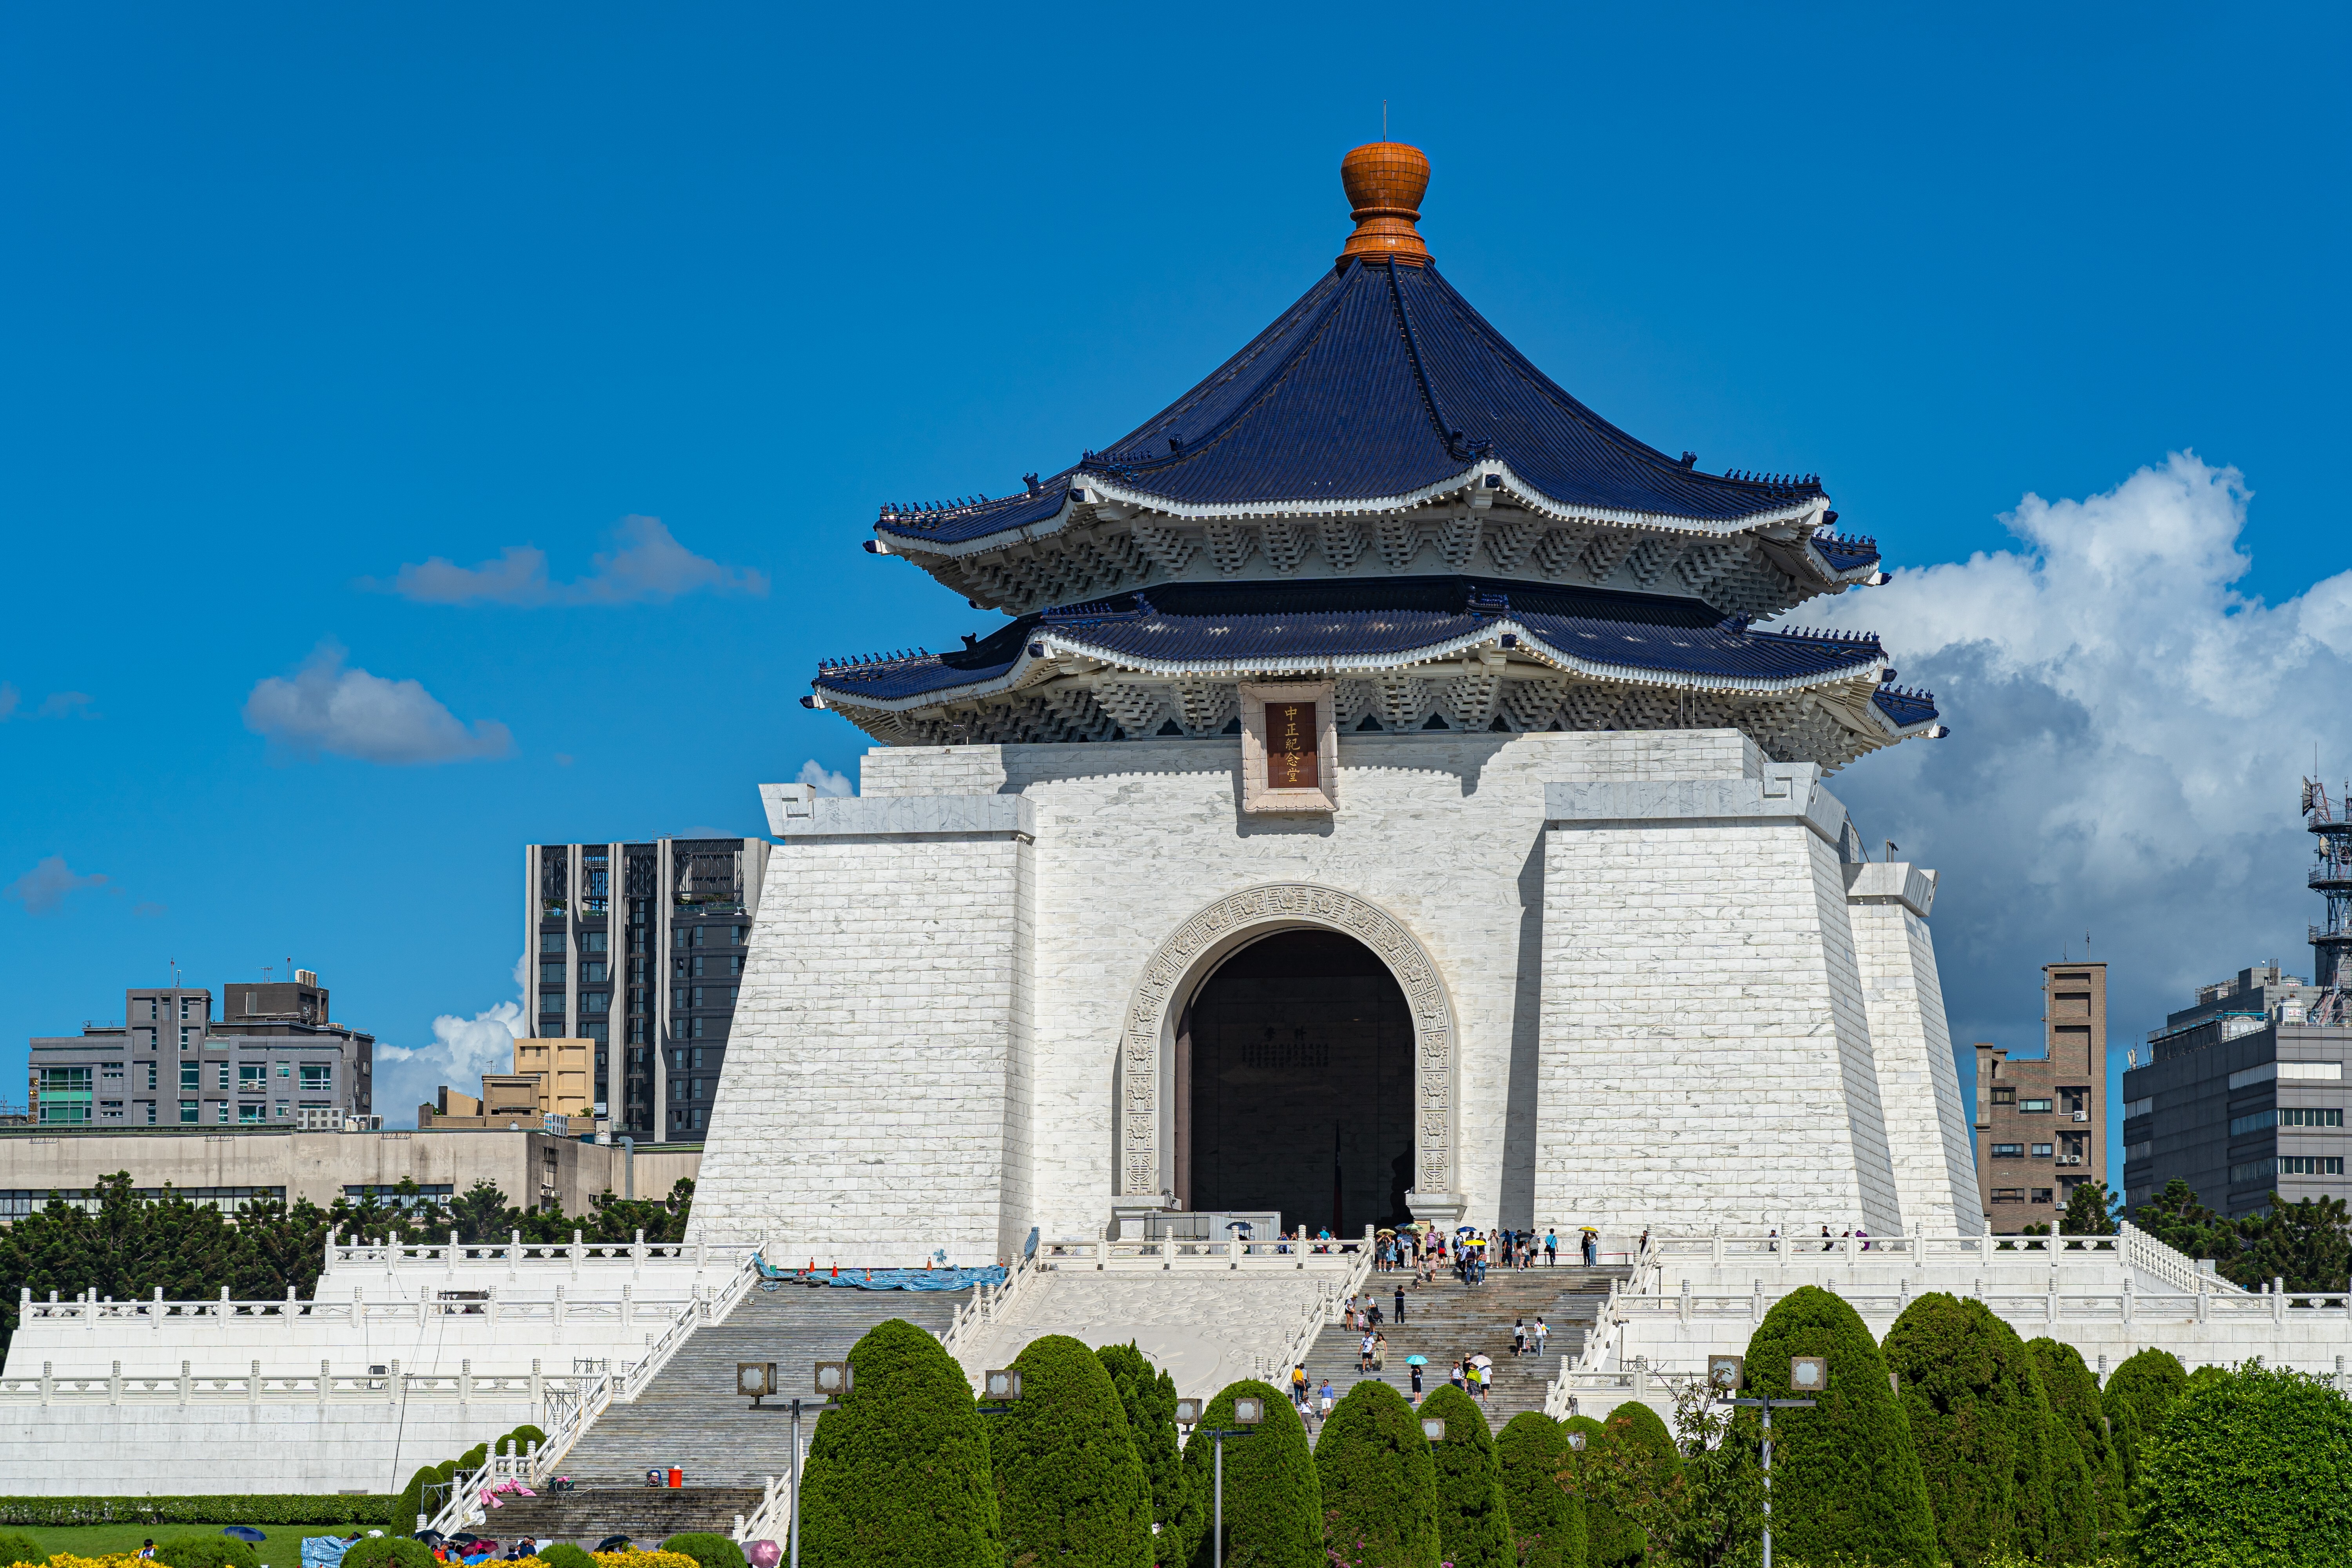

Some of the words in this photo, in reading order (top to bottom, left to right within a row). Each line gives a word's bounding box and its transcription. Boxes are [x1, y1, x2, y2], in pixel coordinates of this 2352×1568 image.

[1285, 706, 1300, 782] 中正紀念堂
